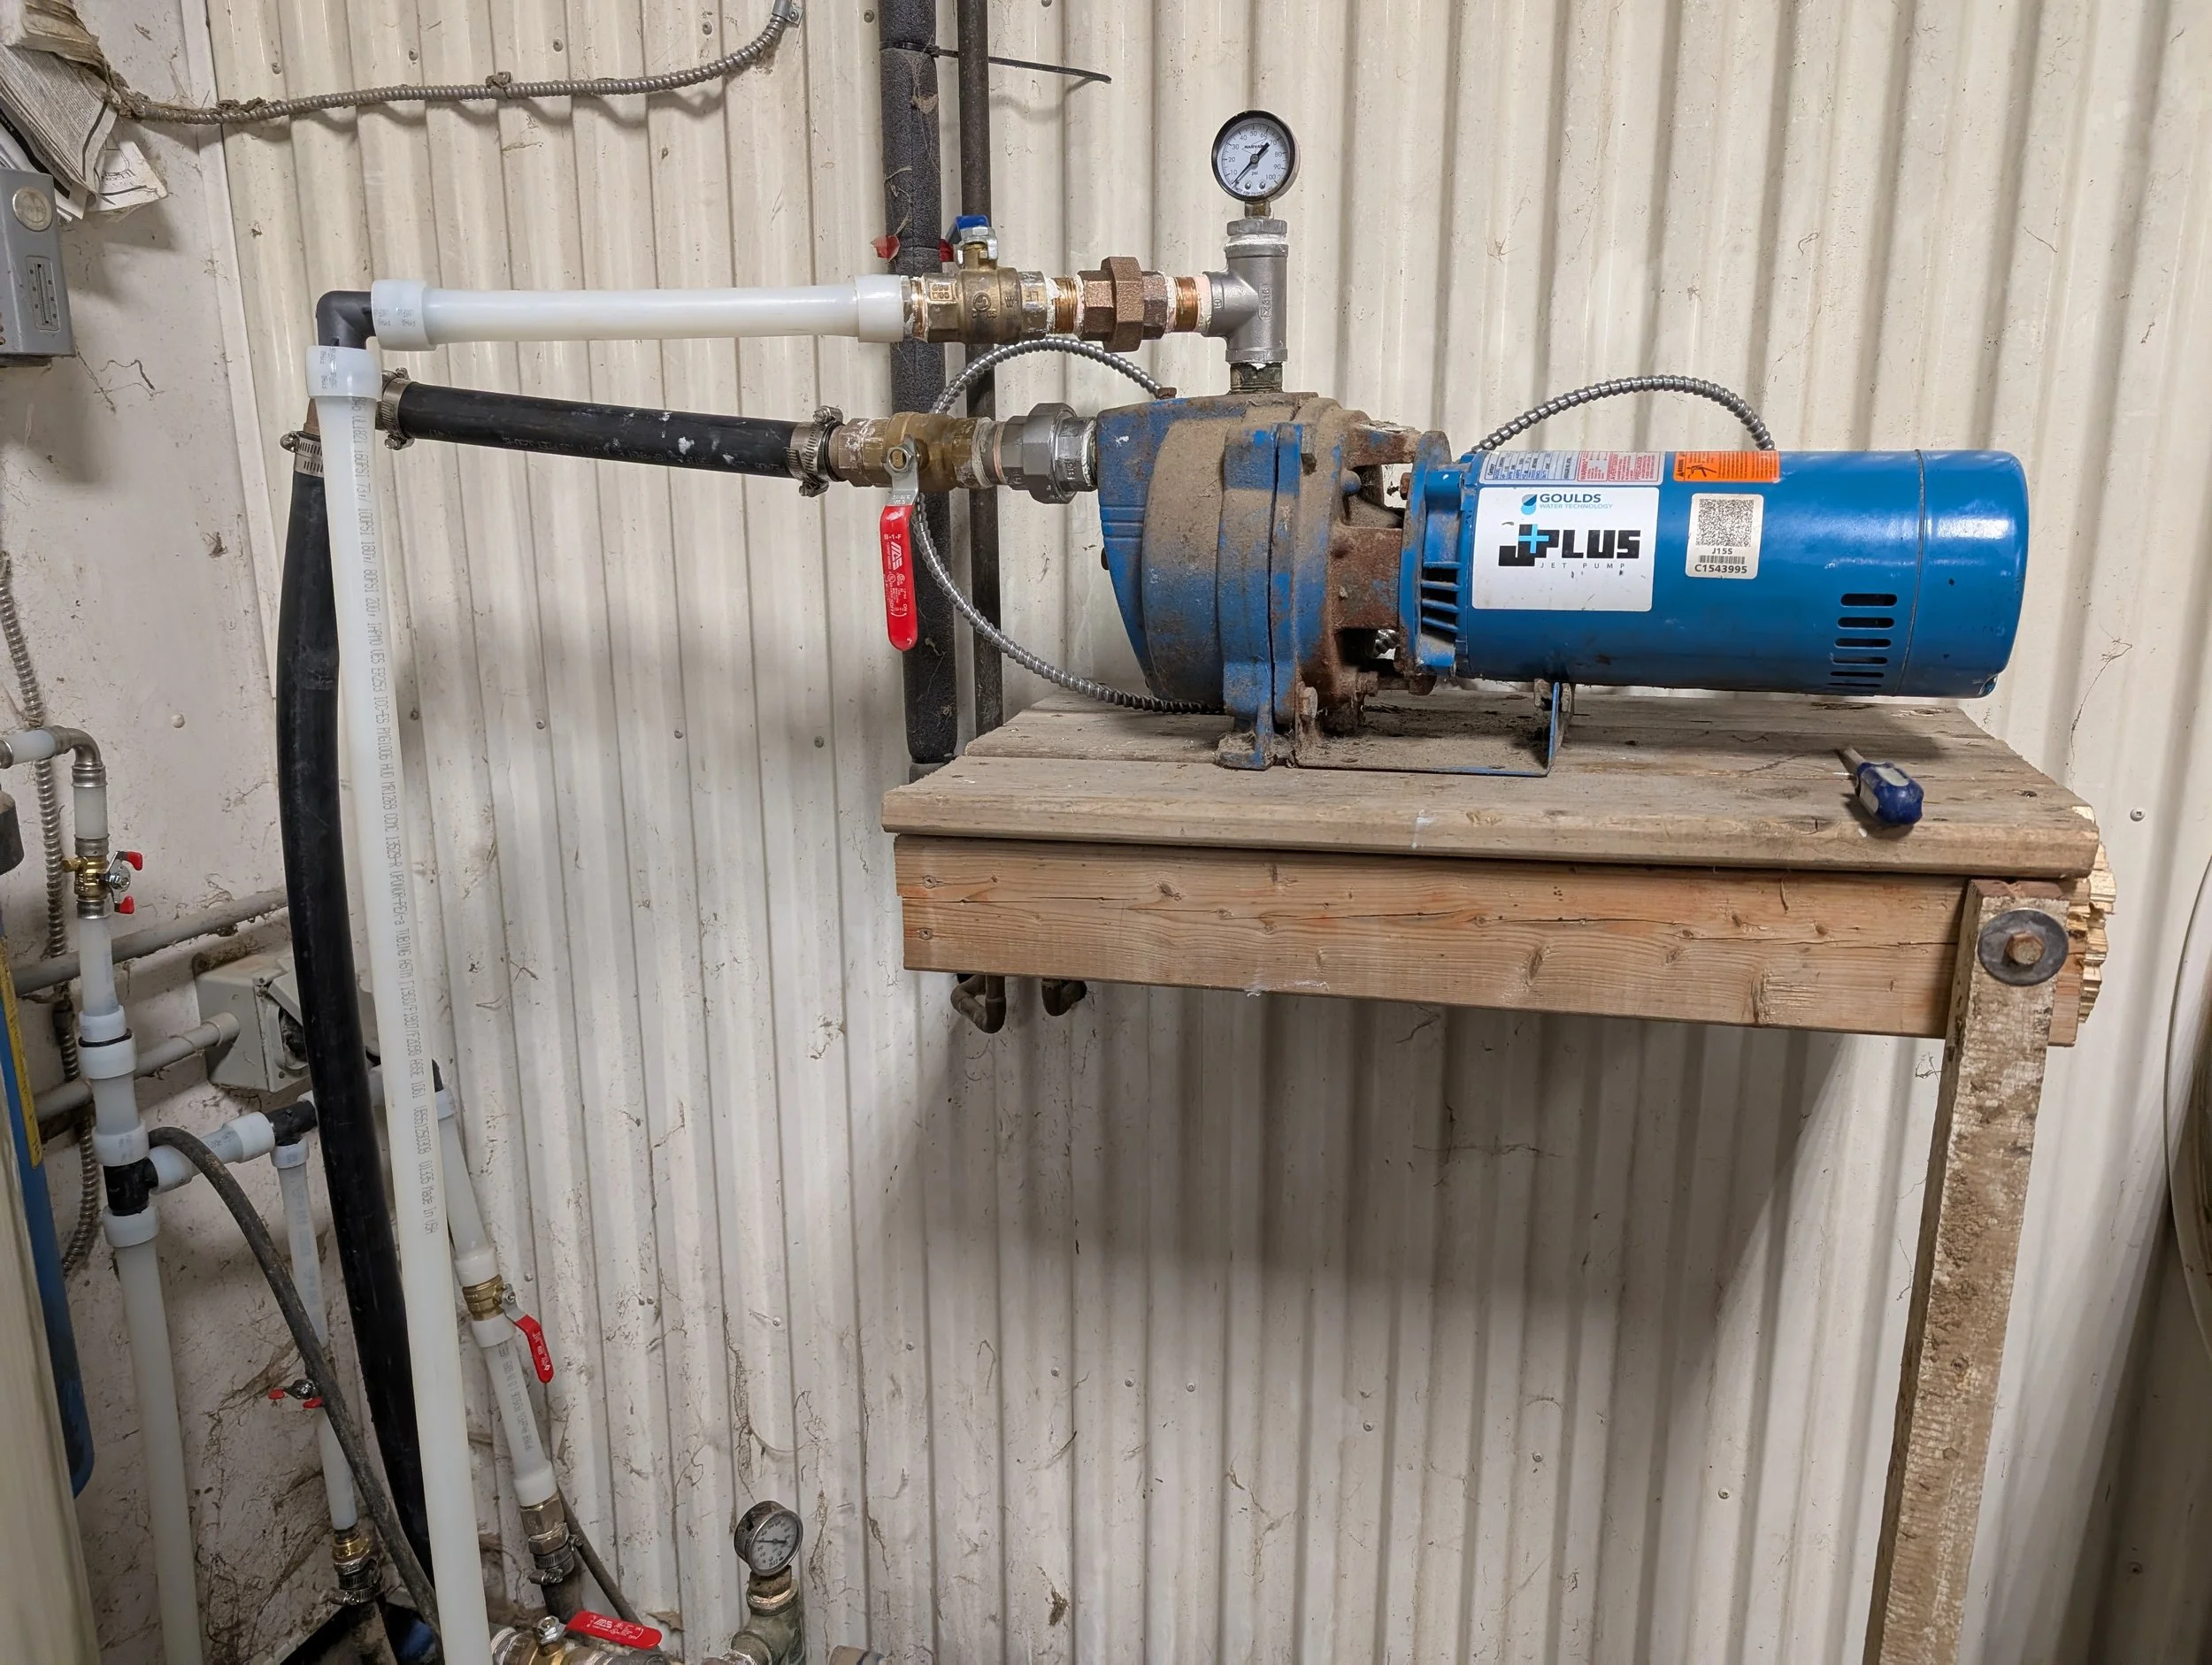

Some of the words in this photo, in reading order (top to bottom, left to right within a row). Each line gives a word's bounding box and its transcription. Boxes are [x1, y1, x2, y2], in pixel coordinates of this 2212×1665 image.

[1539, 493, 1601, 503] GOULDS
[1694, 564, 1747, 574] C1543995
[373, 695, 390, 725] ICC-ES
[396, 928, 411, 956] TUBING
[397, 959, 414, 978] ASTM
[422, 1185, 435, 1205] Made
[425, 1219, 440, 1235] USA
